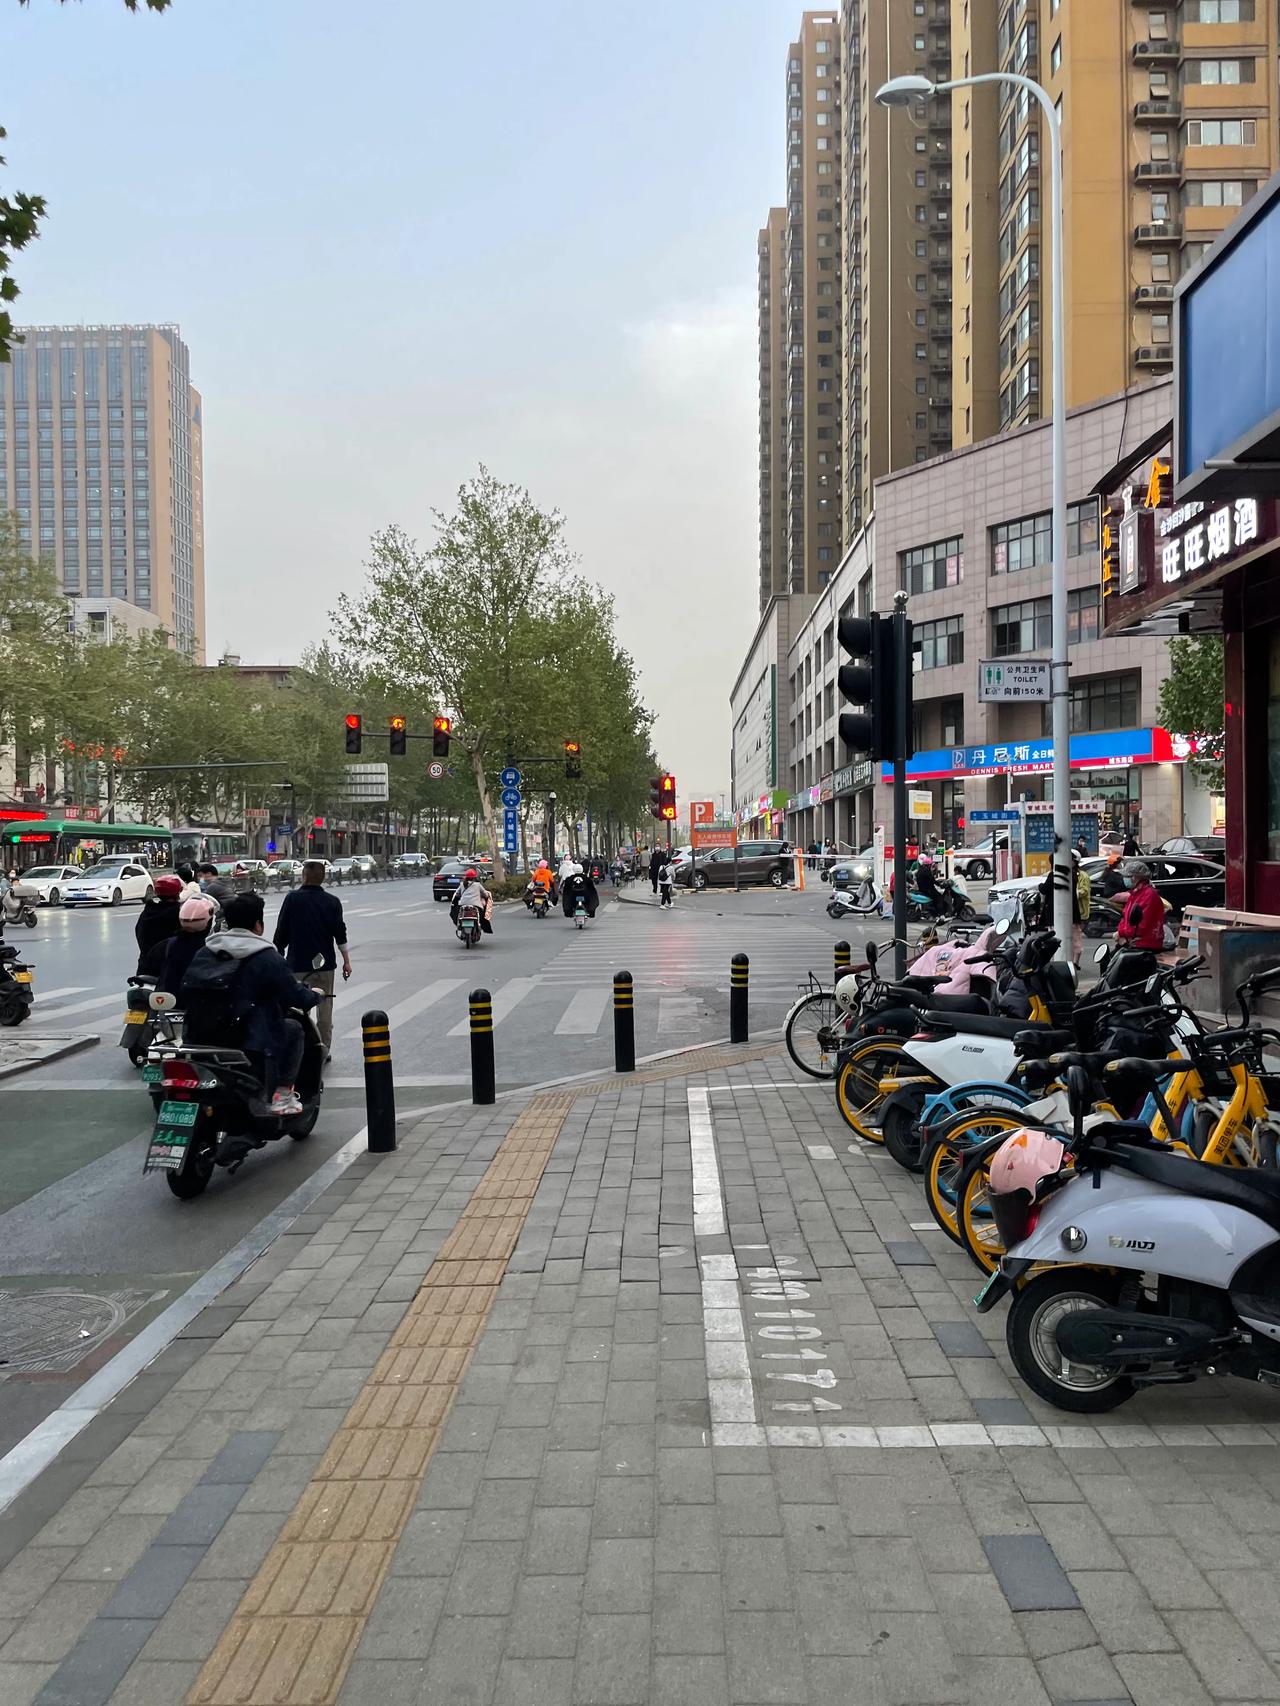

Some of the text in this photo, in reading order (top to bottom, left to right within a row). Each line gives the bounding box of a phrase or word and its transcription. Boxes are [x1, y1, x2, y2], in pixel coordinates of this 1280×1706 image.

[1162, 498, 1257, 583] 旺旺烟酒
[1004, 687, 1044, 696] 向前150米
[972, 746, 1030, 765] 丹尼斯
[971, 767, 999, 775] DENNIS
[695, 804, 706, 822] P
[1213, 1118, 1236, 1156] 美团单车
